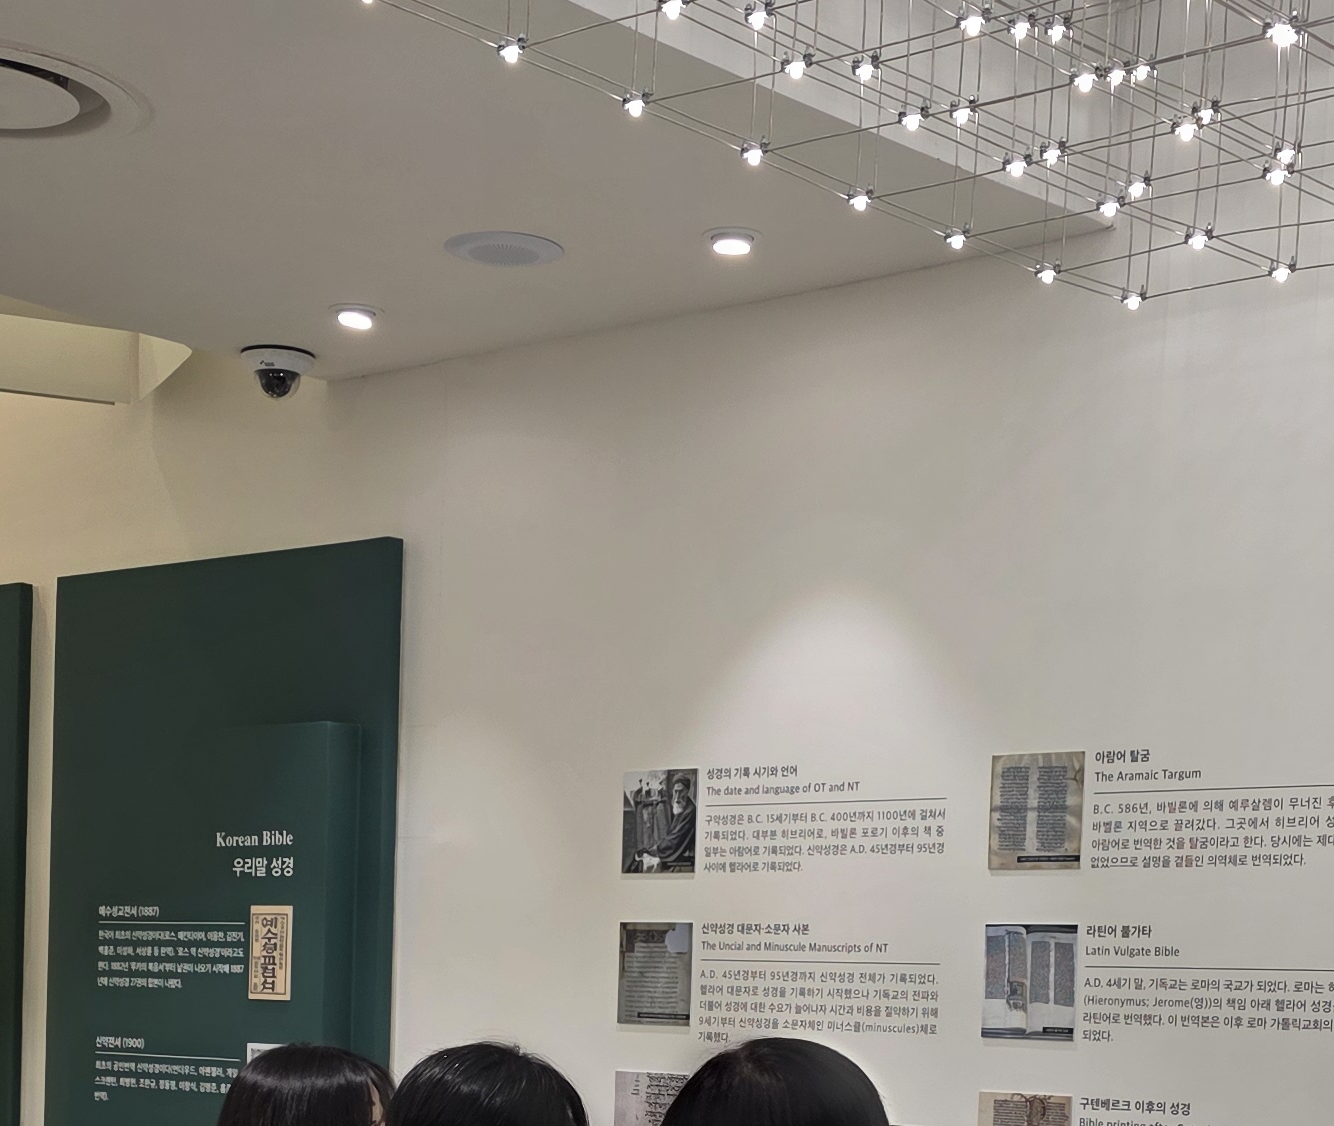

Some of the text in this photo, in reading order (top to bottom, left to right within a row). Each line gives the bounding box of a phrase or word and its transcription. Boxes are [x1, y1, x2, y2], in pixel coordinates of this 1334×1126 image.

[1095, 749, 1150, 764] 아람어 탈굼
[707, 764, 798, 780] 성경의 기록 시기와 언어
[1095, 769, 1201, 782] The Aramaic Targum
[706, 781, 860, 796] The date and language of OT and NT
[216, 830, 293, 847] Korean Bible
[232, 856, 294, 877] 우리말 성경
[701, 922, 810, 936] 신약성경 대문자·소문자 사본
[1086, 925, 1152, 939] 라틴어 불가타
[701, 941, 889, 954] The Uncial and Minuscule Manuscripts of NT
[1085, 945, 1180, 958] Latin Vulgate Bible
[1084, 977, 1103, 988] A.D.
[1106, 977, 1131, 990] 4세기
[1133, 977, 1146, 990] 말,
[1149, 978, 1188, 991] 기독교는
[1190, 979, 1220, 992] 로마의
[1223, 979, 1254, 993] 국교가
[1256, 980, 1290, 994] 되었다.
[1293, 981, 1325, 994] 로마는
[1079, 1097, 1190, 1116] 구텐베르크 이후의 성경
